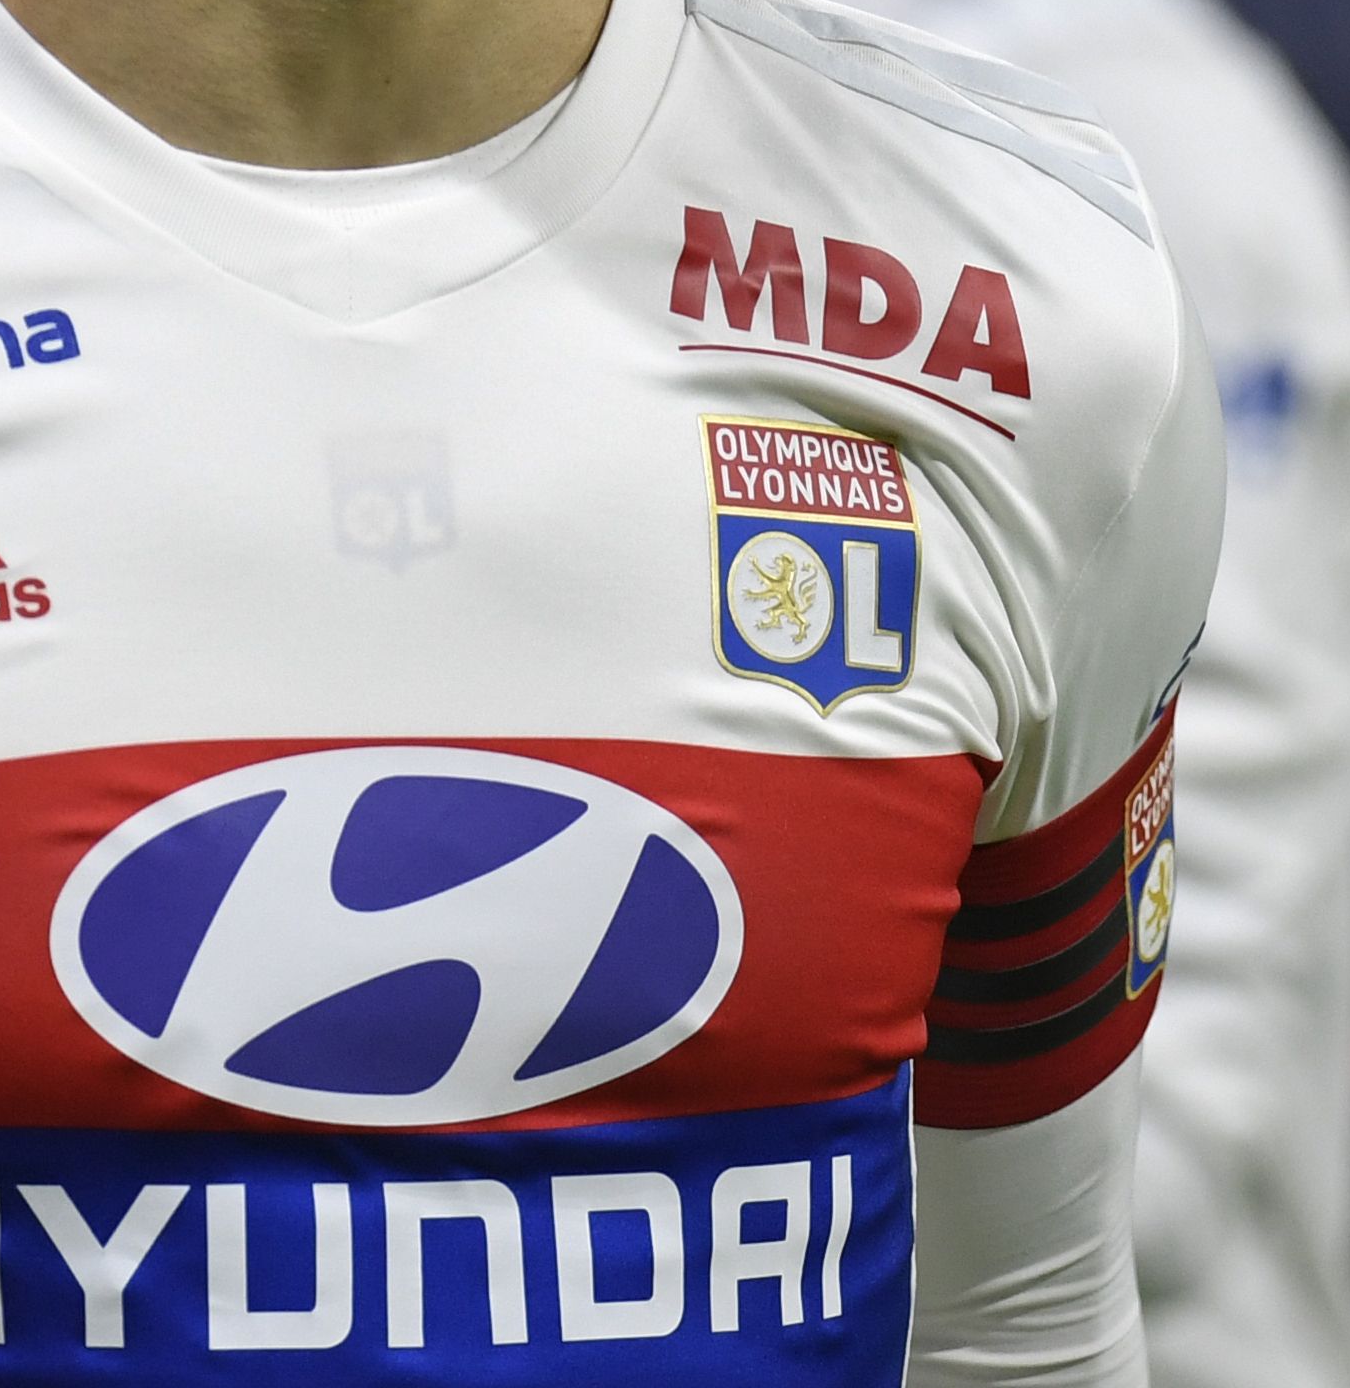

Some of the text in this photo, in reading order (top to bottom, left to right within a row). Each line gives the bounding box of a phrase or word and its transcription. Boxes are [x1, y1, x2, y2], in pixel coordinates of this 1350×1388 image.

[670, 205, 1031, 400] MDA
[715, 427, 895, 478] OLYMPIQUE
[720, 464, 905, 513] LYONNAIS
[727, 530, 903, 673] OL
